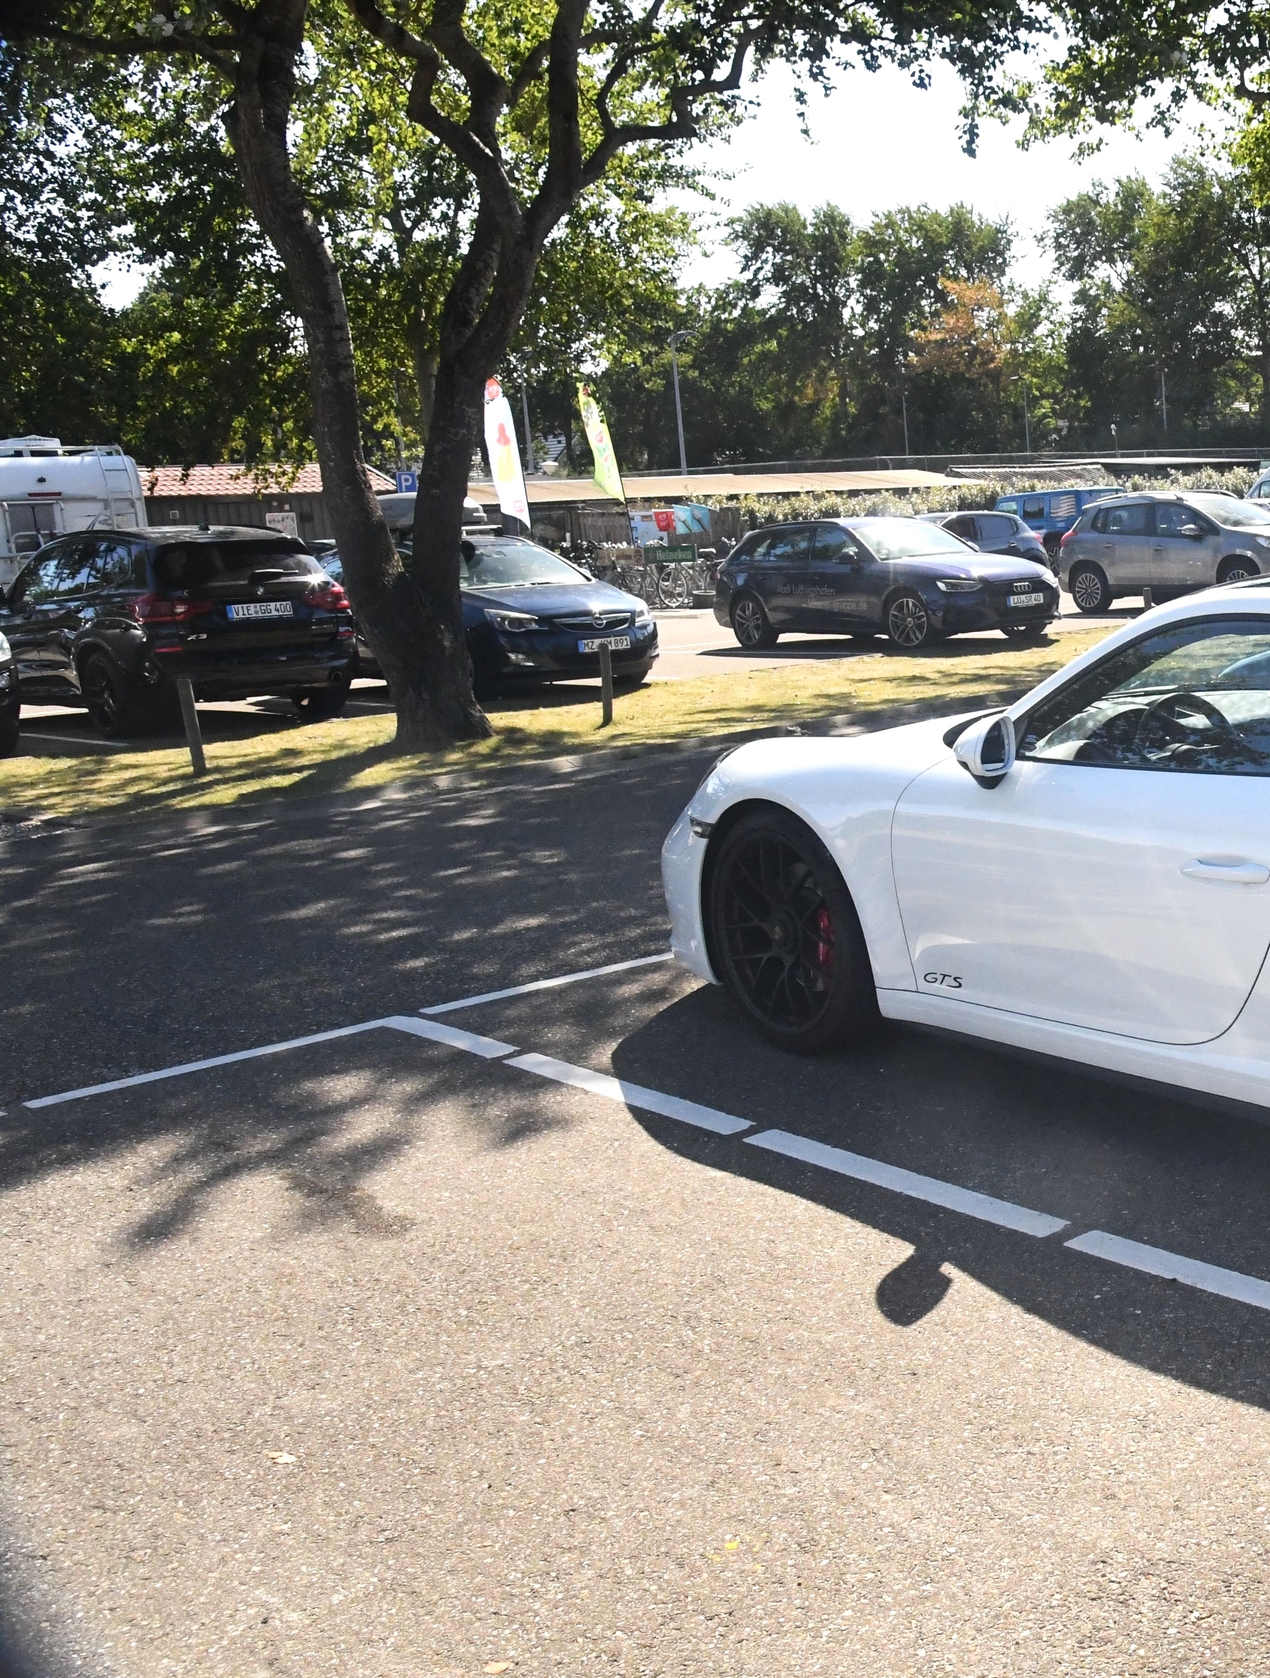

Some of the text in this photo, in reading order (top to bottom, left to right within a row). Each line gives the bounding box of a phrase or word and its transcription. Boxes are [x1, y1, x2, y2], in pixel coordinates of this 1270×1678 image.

[401, 475, 412, 491] P
[656, 549, 692, 560] Heineken
[233, 602, 292, 617] VIE GG 400
[583, 641, 595, 650] MZ
[614, 637, 629, 647] 891
[923, 972, 963, 988] GTS
